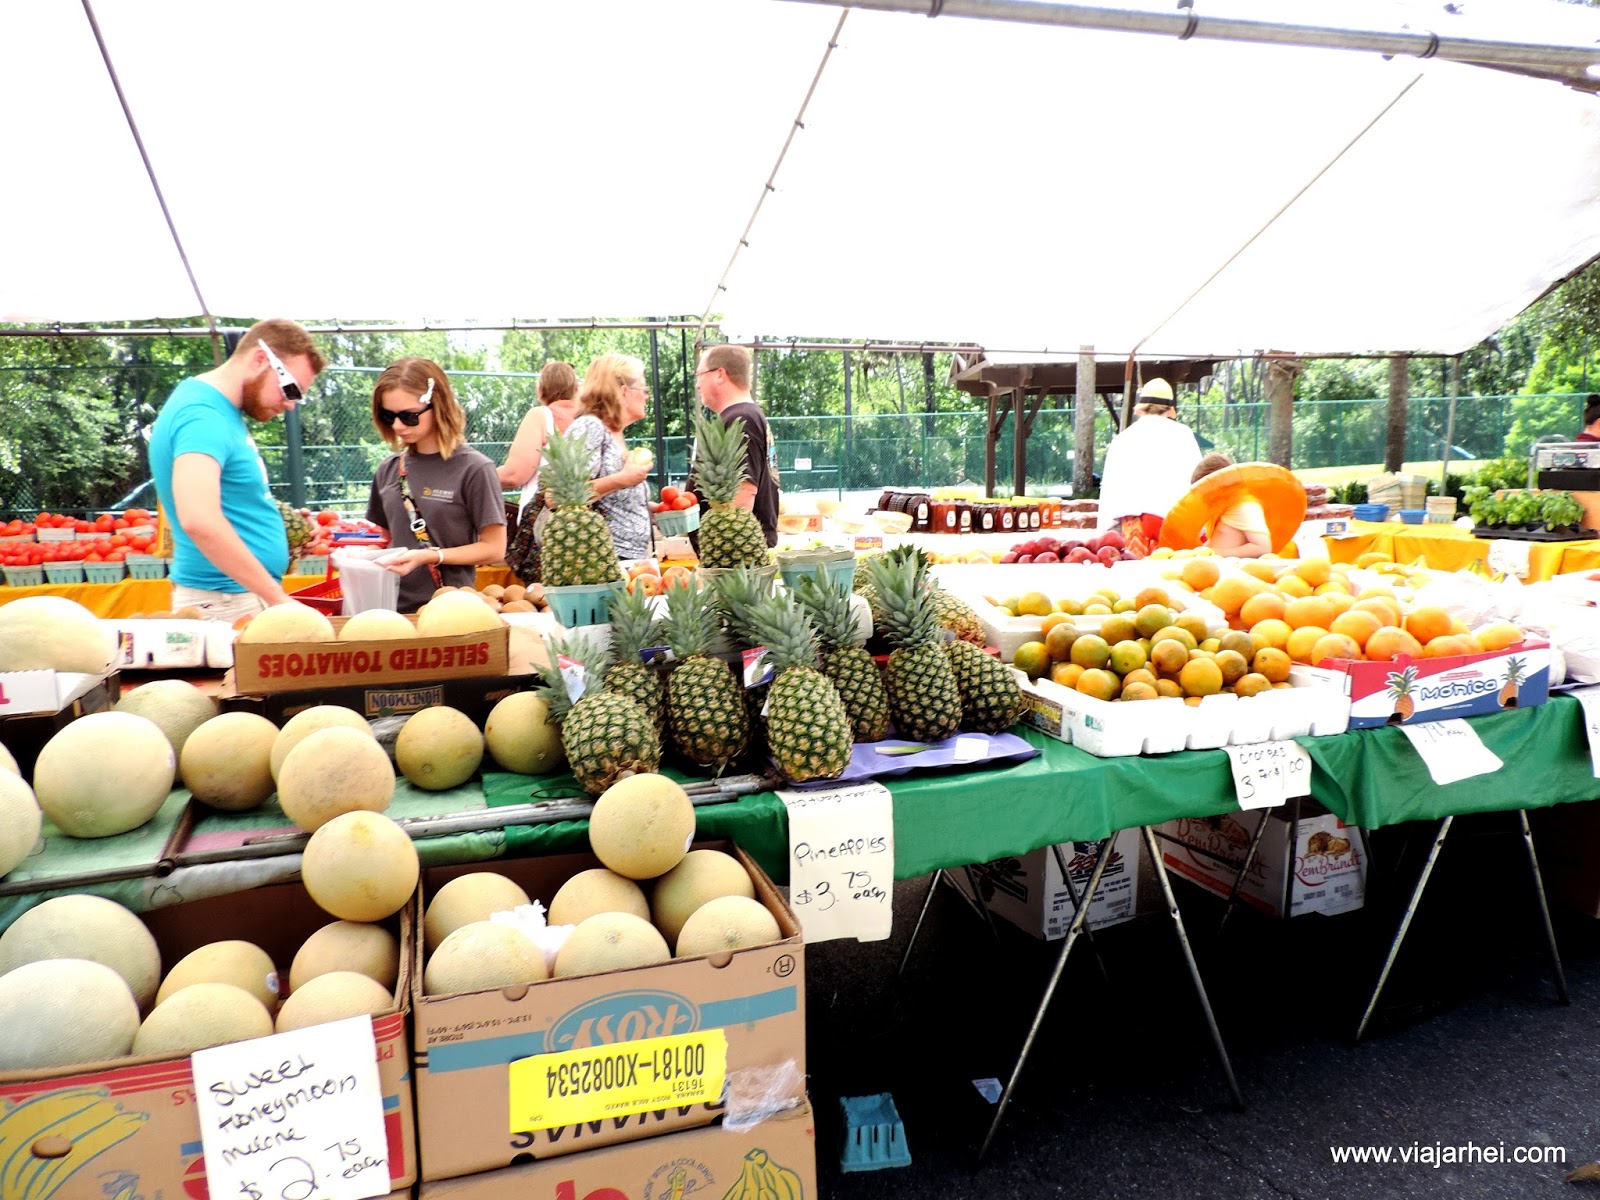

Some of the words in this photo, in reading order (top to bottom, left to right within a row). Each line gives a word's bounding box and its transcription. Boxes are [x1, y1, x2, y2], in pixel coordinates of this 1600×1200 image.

[257, 650, 383, 679] TOMATOES
[389, 642, 490, 671] SELECTED
[371, 689, 442, 708] HONEYMOON
[569, 1004, 679, 1049] ROSY
[546, 1043, 705, 1099] 00181-X0082534
[671, 1078, 704, 1093] 16131
